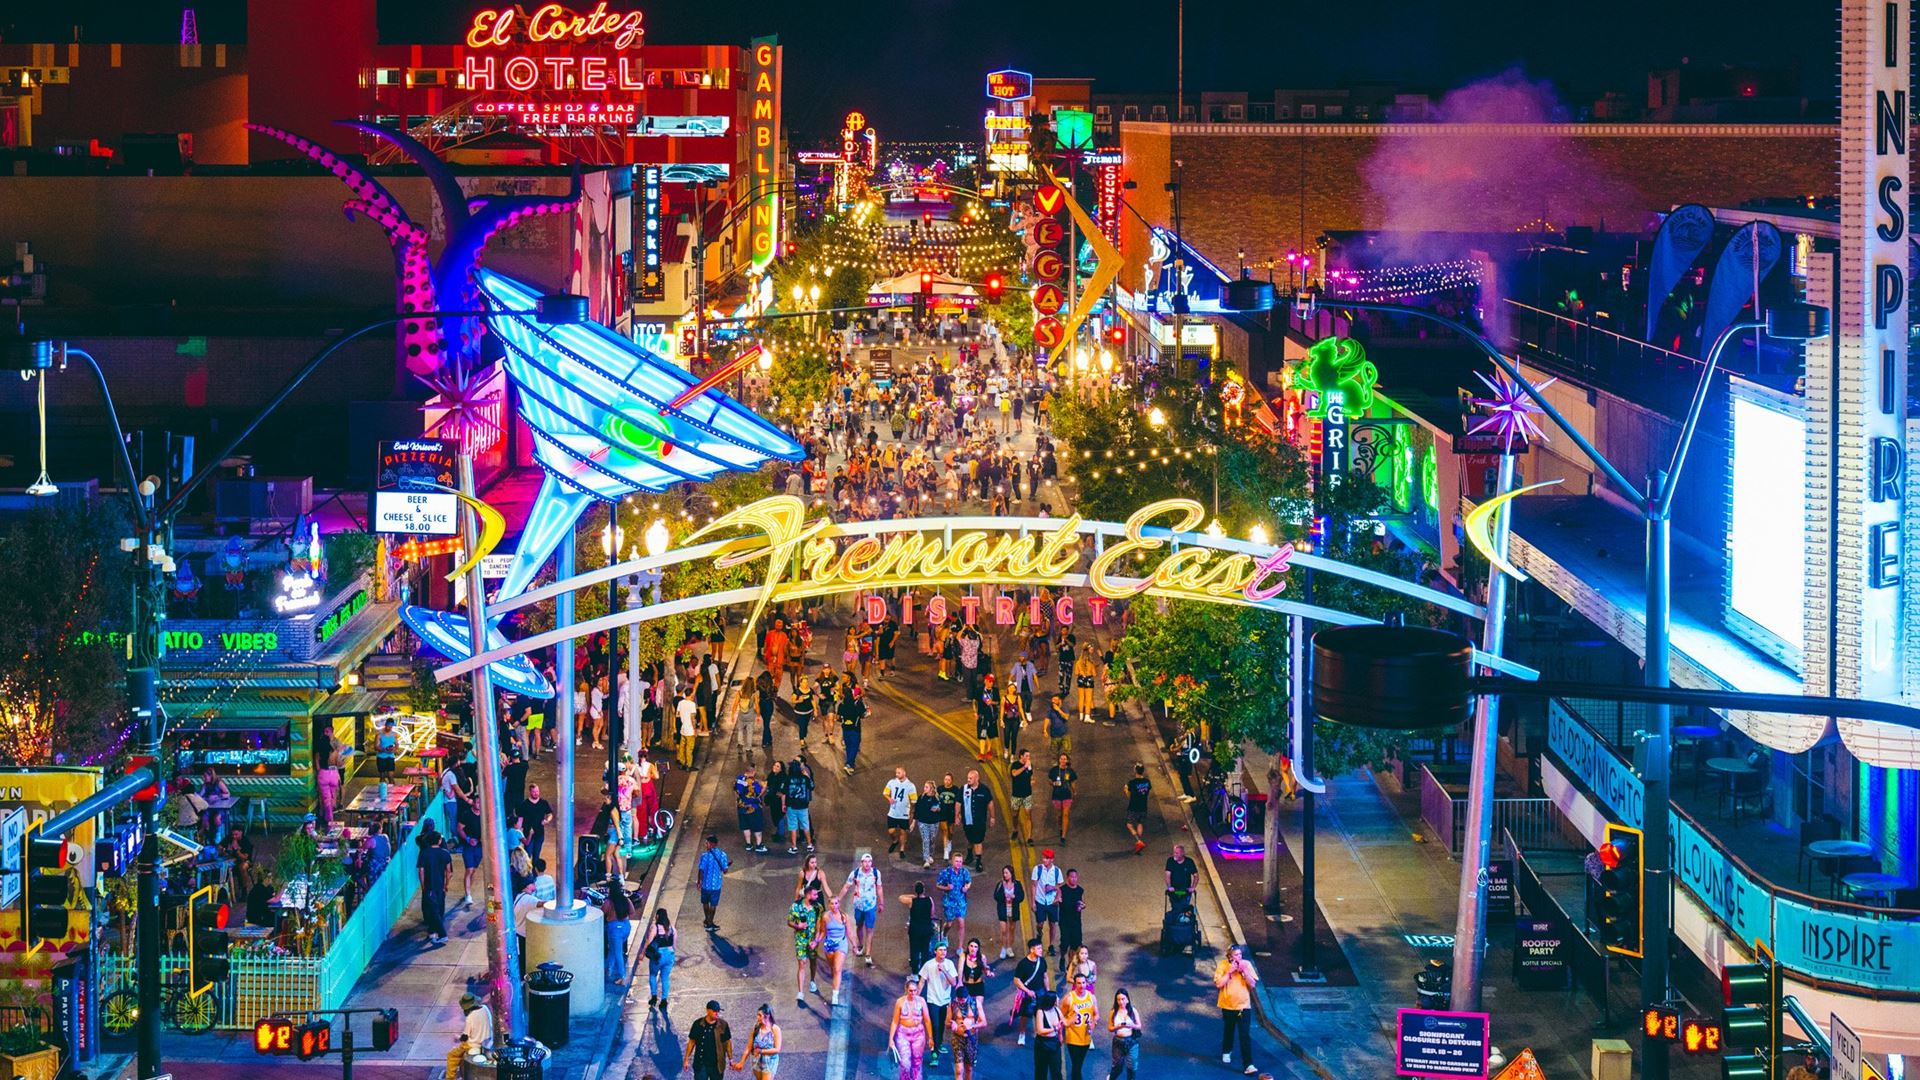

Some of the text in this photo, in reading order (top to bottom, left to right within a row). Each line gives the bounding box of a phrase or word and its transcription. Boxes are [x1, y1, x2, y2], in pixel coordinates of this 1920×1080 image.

[467, 2, 645, 50] El Cortez
[466, 56, 645, 91] HOTEL
[476, 103, 635, 112] COFFEE SHOP & BAR
[523, 114, 634, 123] FREE PARKING
[754, 45, 772, 253] GAMBLING
[1083, 156, 1121, 165] Fremont
[1105, 166, 1116, 216] COUNTRY
[646, 168, 657, 266] Eureka
[1036, 189, 1064, 345] VEGAS
[1868, 2, 1906, 590] INSPIRE
[384, 452, 453, 468] PIZZERIA
[407, 495, 428, 504] BEER
[383, 512, 448, 523] CHEESE SLICE
[405, 523, 431, 531] $8.00
[680, 496, 1296, 651] Fremont East
[866, 596, 1110, 625] DISTRICT
[163, 631, 278, 650] ATIO VIBES
[1551, 711, 1642, 827] 3 FLOORS NIGHTC
[895, 787, 905, 802] 14
[8, 821, 18, 842] NO
[1683, 836, 1745, 929] LOUNGE
[1404, 934, 1456, 945] INSP
[1522, 940, 1561, 948] ROOFTOP
[1802, 920, 1893, 971] INSPIRE
[61, 979, 70, 990] P
[1075, 1012, 1090, 1026] 32
[1403, 1036, 1440, 1044] CLOSURES
[1448, 1039, 1481, 1047] DETOURS
[1419, 1031, 1465, 1039] SIGNIFICANT
[1836, 1030, 1855, 1064] YIELD
